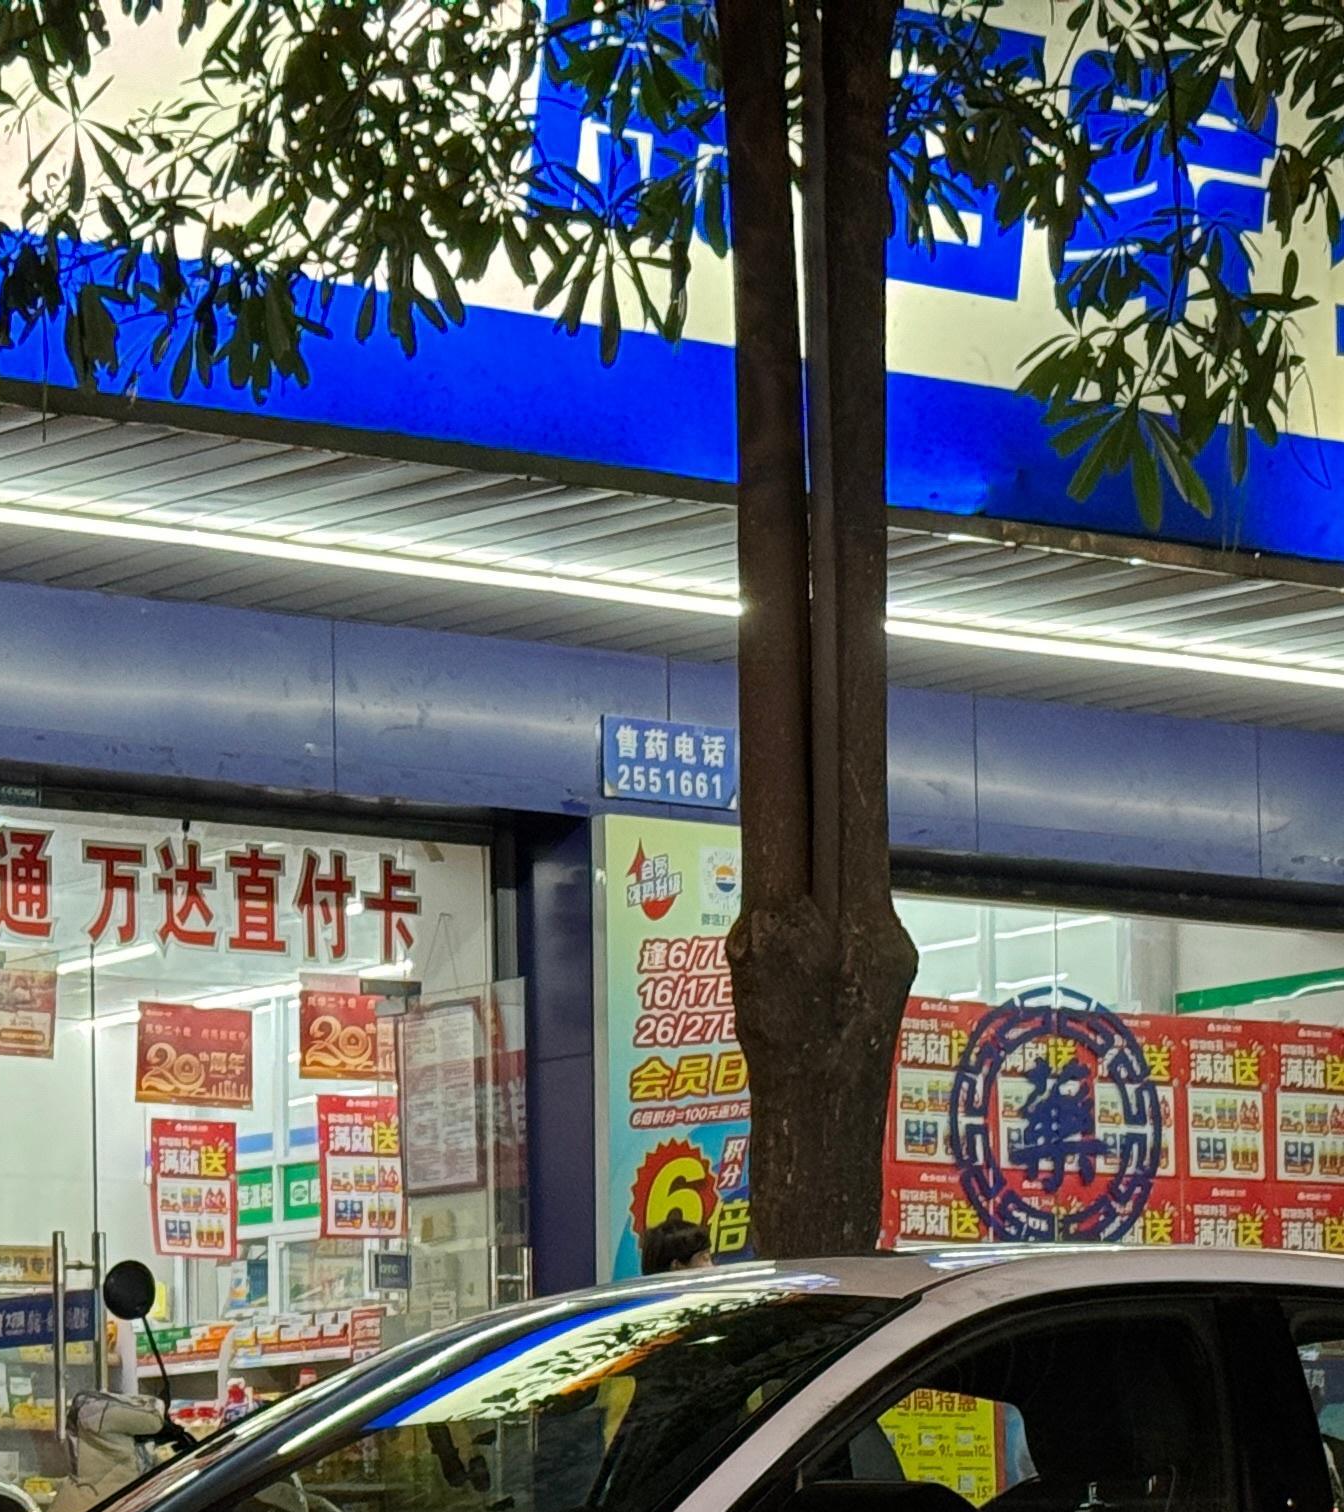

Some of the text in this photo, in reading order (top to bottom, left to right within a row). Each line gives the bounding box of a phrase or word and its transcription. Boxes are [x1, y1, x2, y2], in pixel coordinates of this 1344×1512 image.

[616, 725, 726, 768] 售药电话
[617, 765, 723, 799] 2551661
[82, 836, 422, 963] 万达直付卡
[631, 1053, 748, 1100] 会员日
[1190, 1049, 1259, 1087] 满就送
[900, 1199, 979, 1238] 满就送
[1193, 1213, 1263, 1248] 满就送
